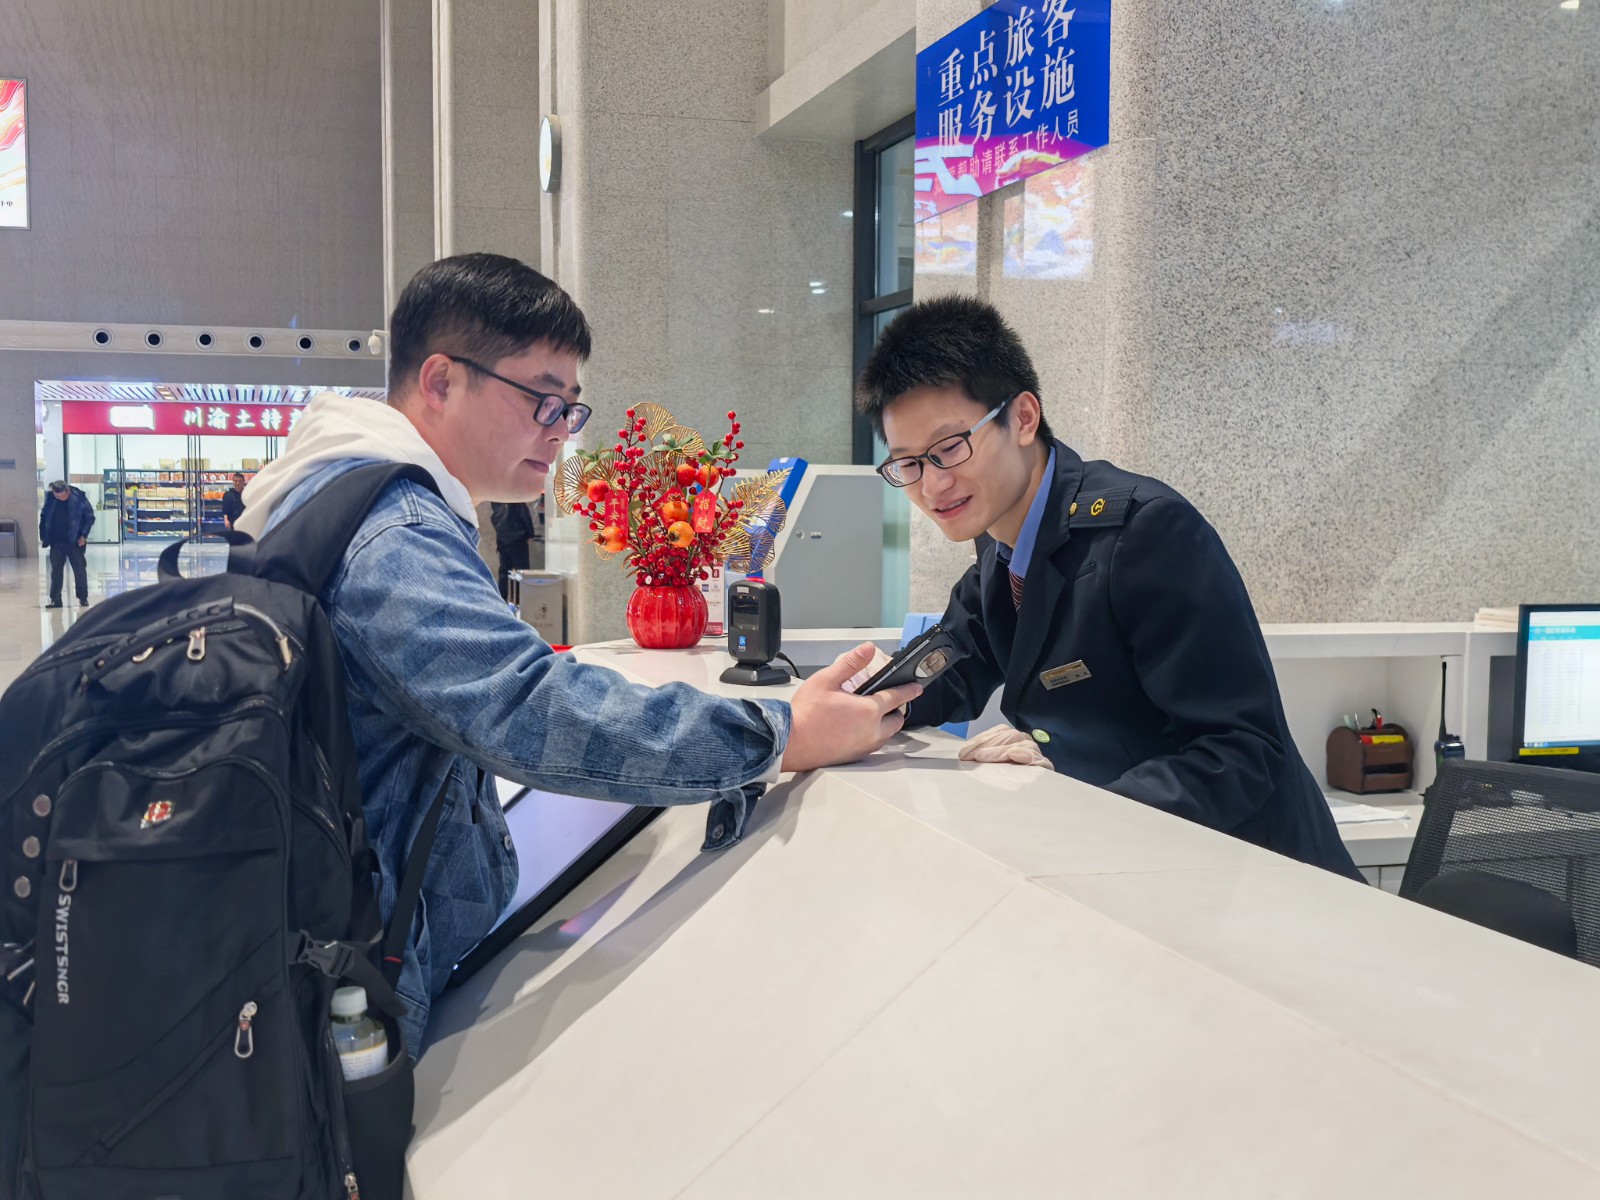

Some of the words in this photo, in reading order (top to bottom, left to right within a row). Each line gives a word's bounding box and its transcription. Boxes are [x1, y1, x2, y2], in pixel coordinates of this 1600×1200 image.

[938, 0, 1076, 106] 重点旅客
[938, 46, 1076, 157] 服务设施
